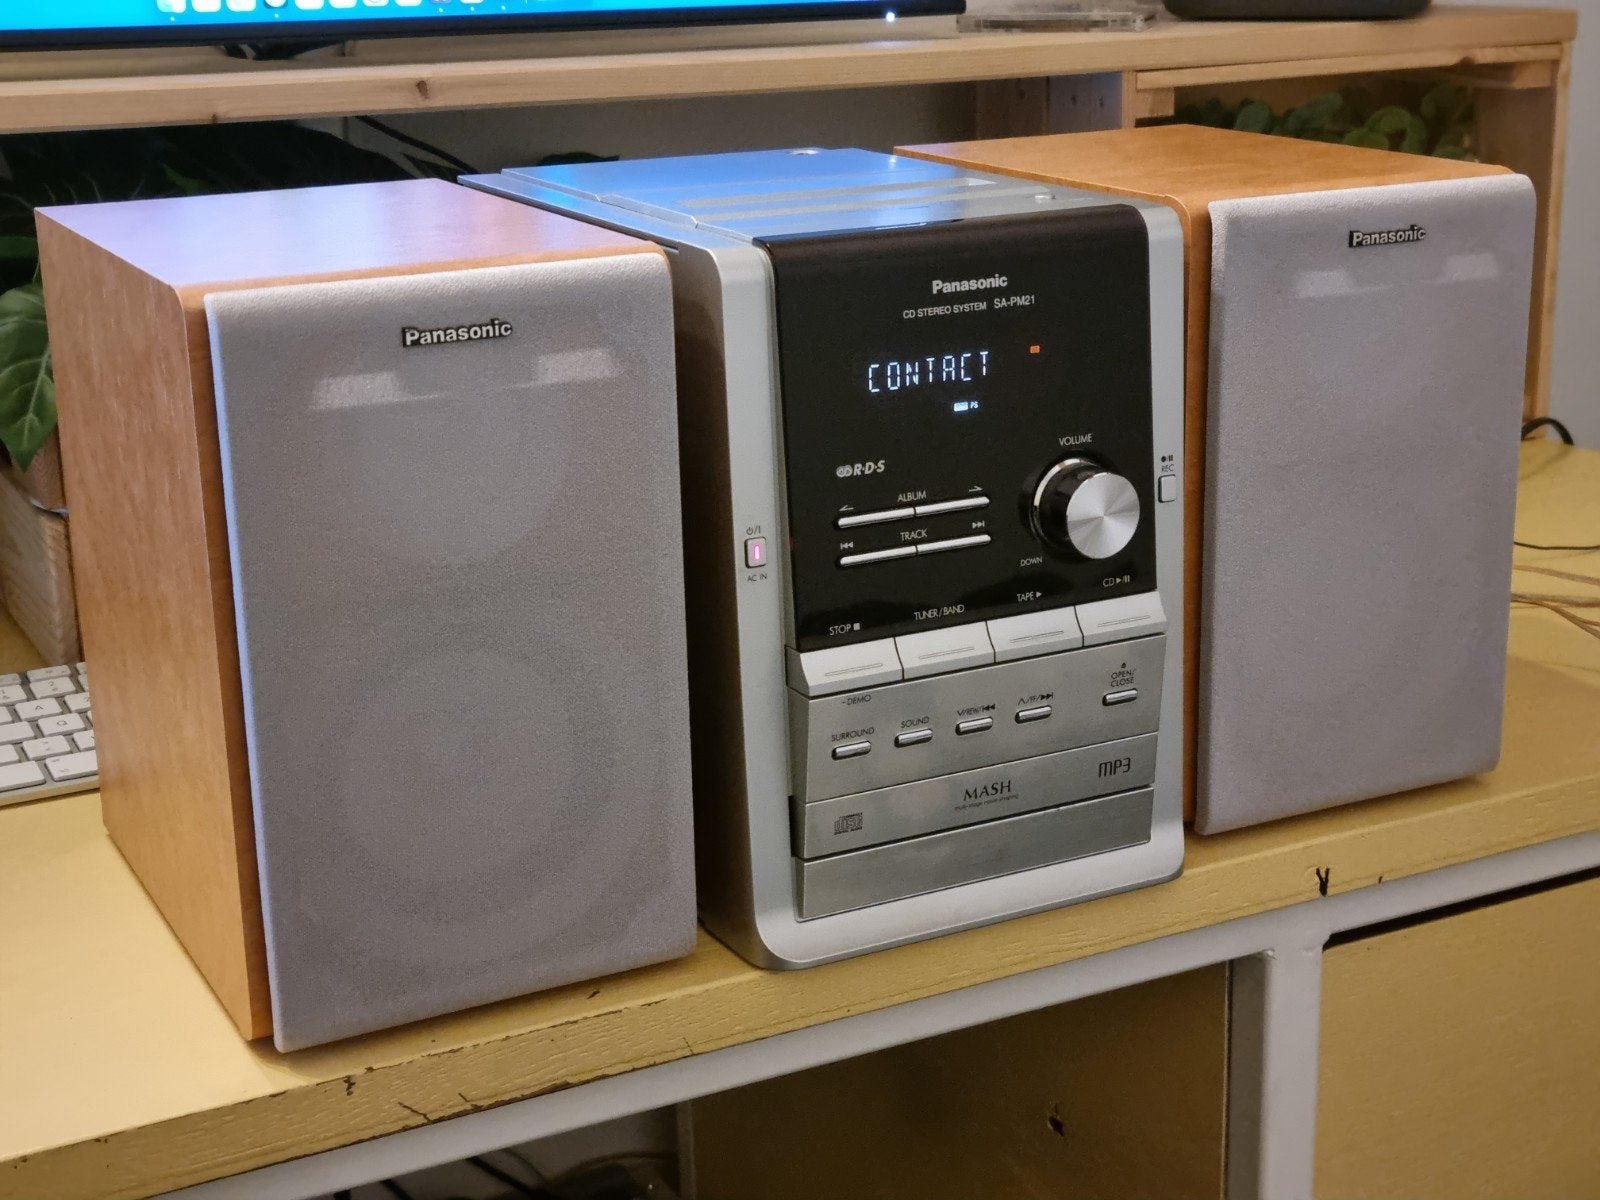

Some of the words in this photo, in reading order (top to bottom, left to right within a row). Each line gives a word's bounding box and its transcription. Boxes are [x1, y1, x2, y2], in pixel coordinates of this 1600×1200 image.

[1349, 225, 1426, 248] Panasonic
[932, 273, 1008, 295] Panasonic
[903, 309, 916, 319] CD
[917, 305, 952, 318] STEREO
[953, 301, 987, 313] SYSTEM
[994, 295, 1035, 309] SA-PM21
[401, 318, 513, 348] Panasonic
[868, 351, 989, 393] CONTACT
[1058, 433, 1093, 446] VOLUME
[1161, 463, 1175, 473] REC
[897, 490, 927, 503] ALBUM
[900, 529, 928, 541] TRACK
[1020, 556, 1043, 567] DOWN
[747, 574, 758, 582] AC
[1102, 577, 1115, 587] CD
[1016, 591, 1035, 602] TAPE
[829, 623, 852, 636] STOP
[1110, 677, 1135, 688] CLOSE
[900, 715, 930, 729] SOUND
[831, 726, 875, 743] SURROUND
[1098, 757, 1132, 779] MP3
[963, 779, 1012, 802] MASH
